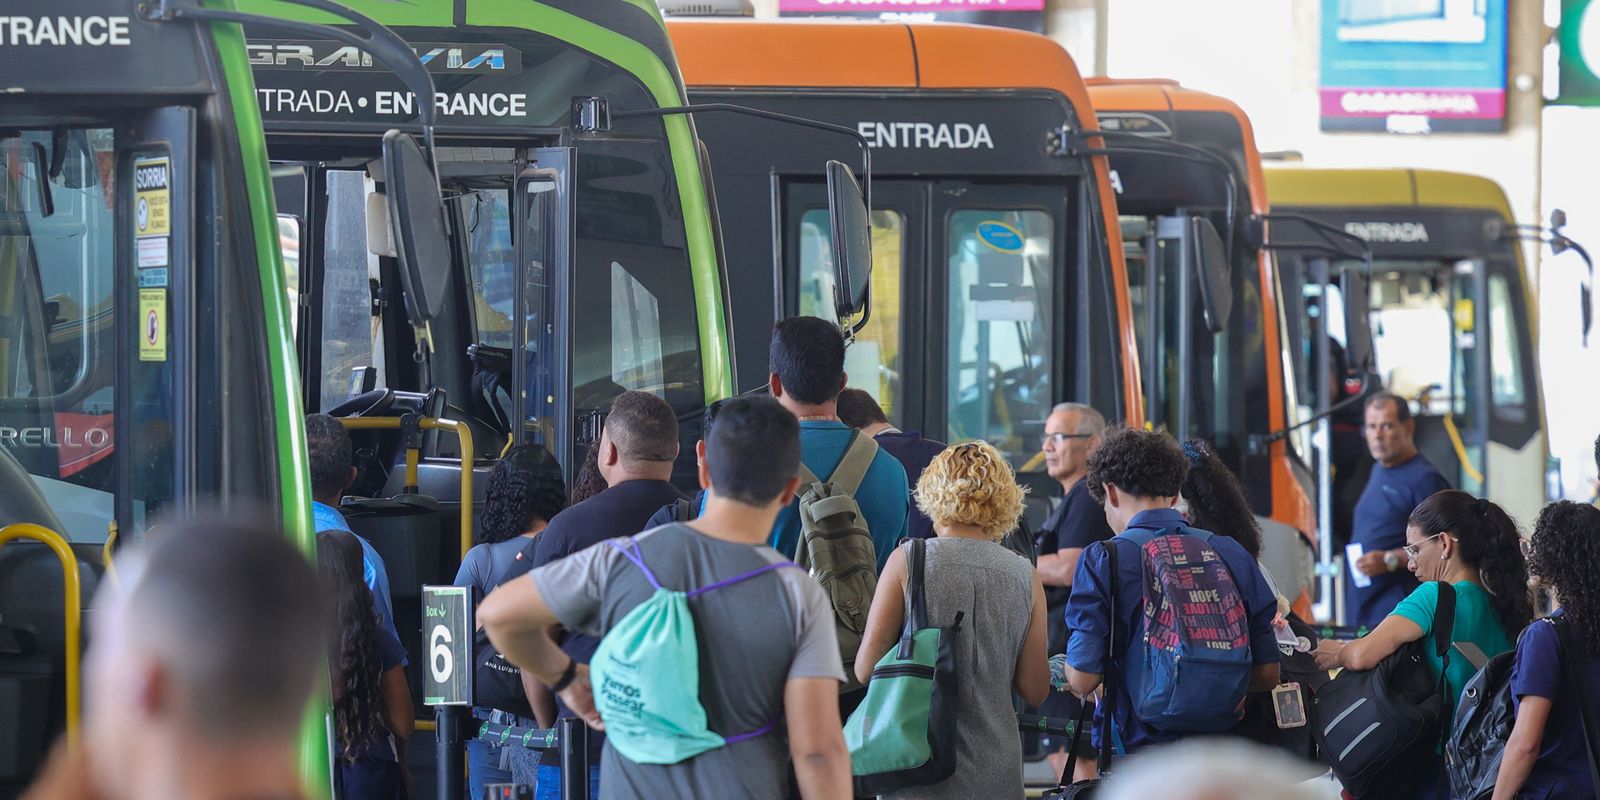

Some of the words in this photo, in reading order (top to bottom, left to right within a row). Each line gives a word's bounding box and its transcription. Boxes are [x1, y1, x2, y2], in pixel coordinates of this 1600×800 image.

[256, 88, 354, 114] TRADA
[857, 122, 994, 149] ENTRADA
[136, 166, 167, 189] SORRIA
[1188, 589, 1221, 603] HOPE
[426, 605, 438, 617] Box
[430, 624, 453, 684] 6
[485, 661, 497, 669] ANA
